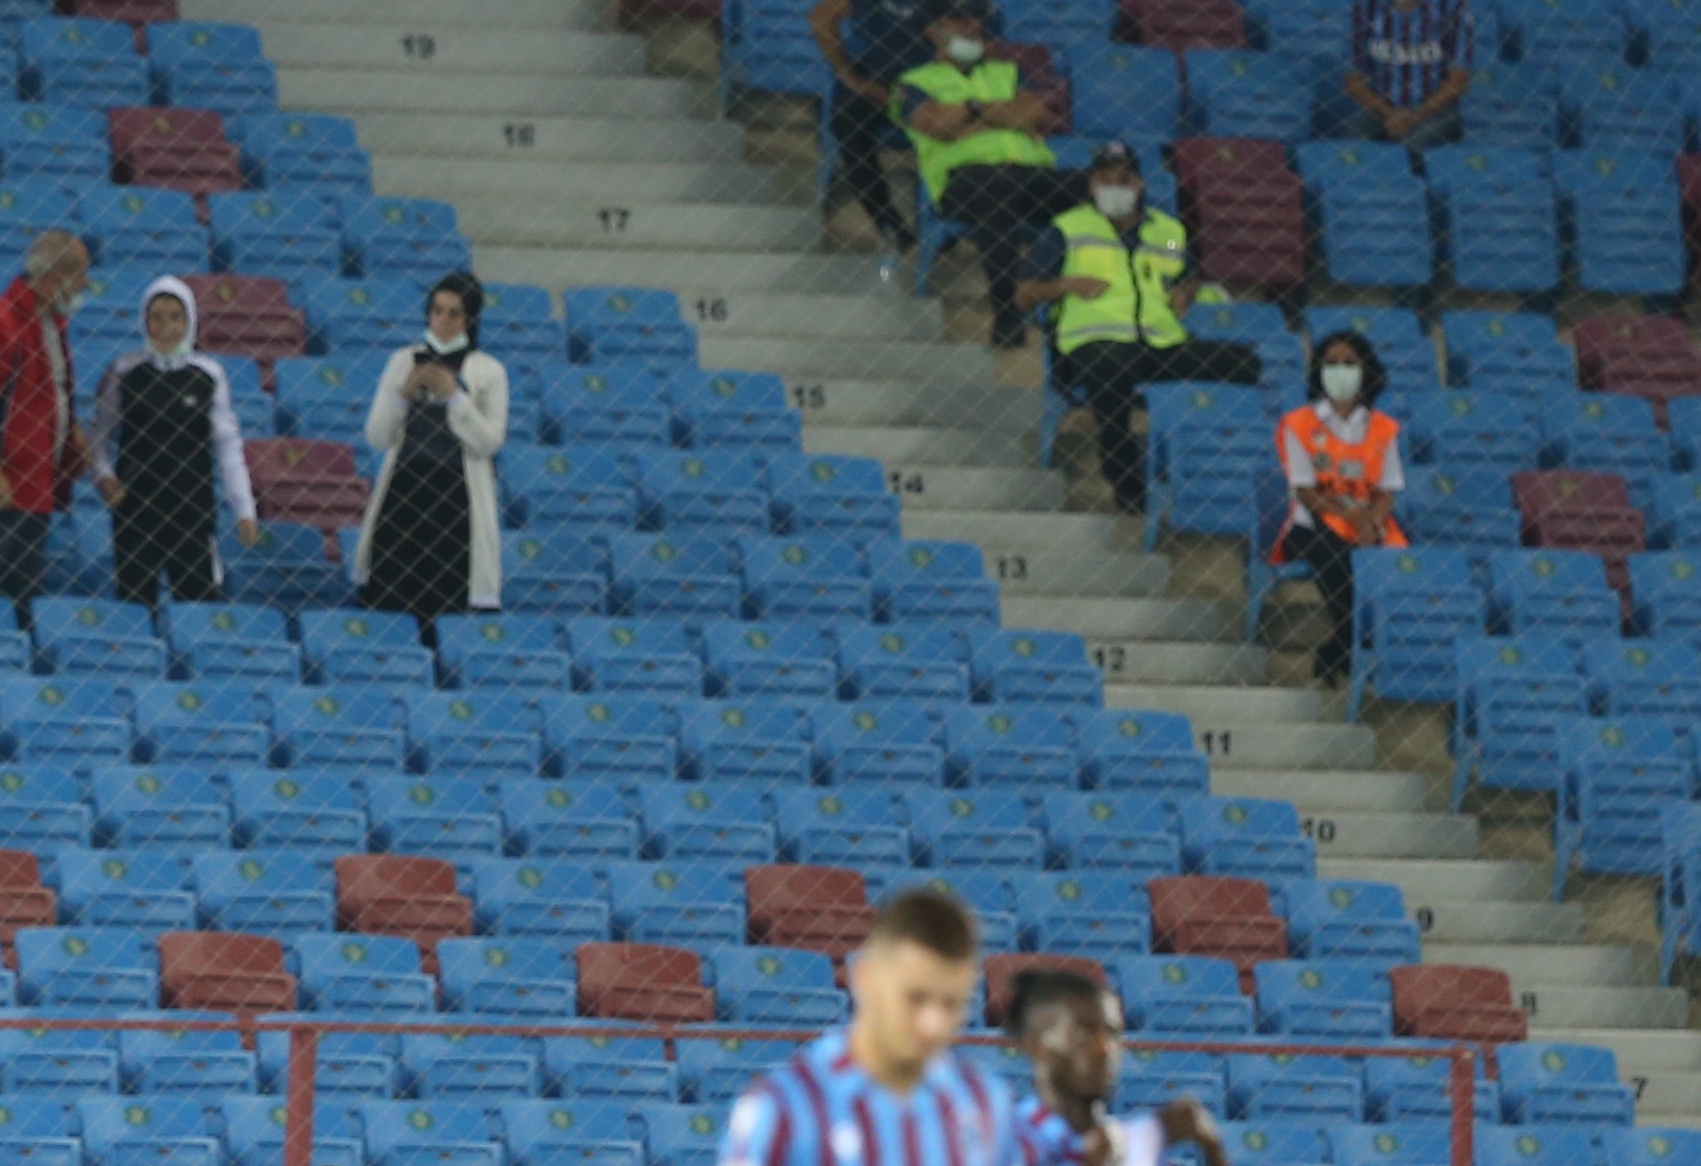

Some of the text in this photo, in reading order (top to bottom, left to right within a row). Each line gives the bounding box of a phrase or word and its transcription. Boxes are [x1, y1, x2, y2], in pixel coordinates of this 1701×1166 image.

[598, 208, 631, 232] 17
[997, 556, 1029, 579] 13
[1202, 730, 1230, 753] 11
[1302, 818, 1336, 843] 10
[1417, 906, 1434, 932] 9
